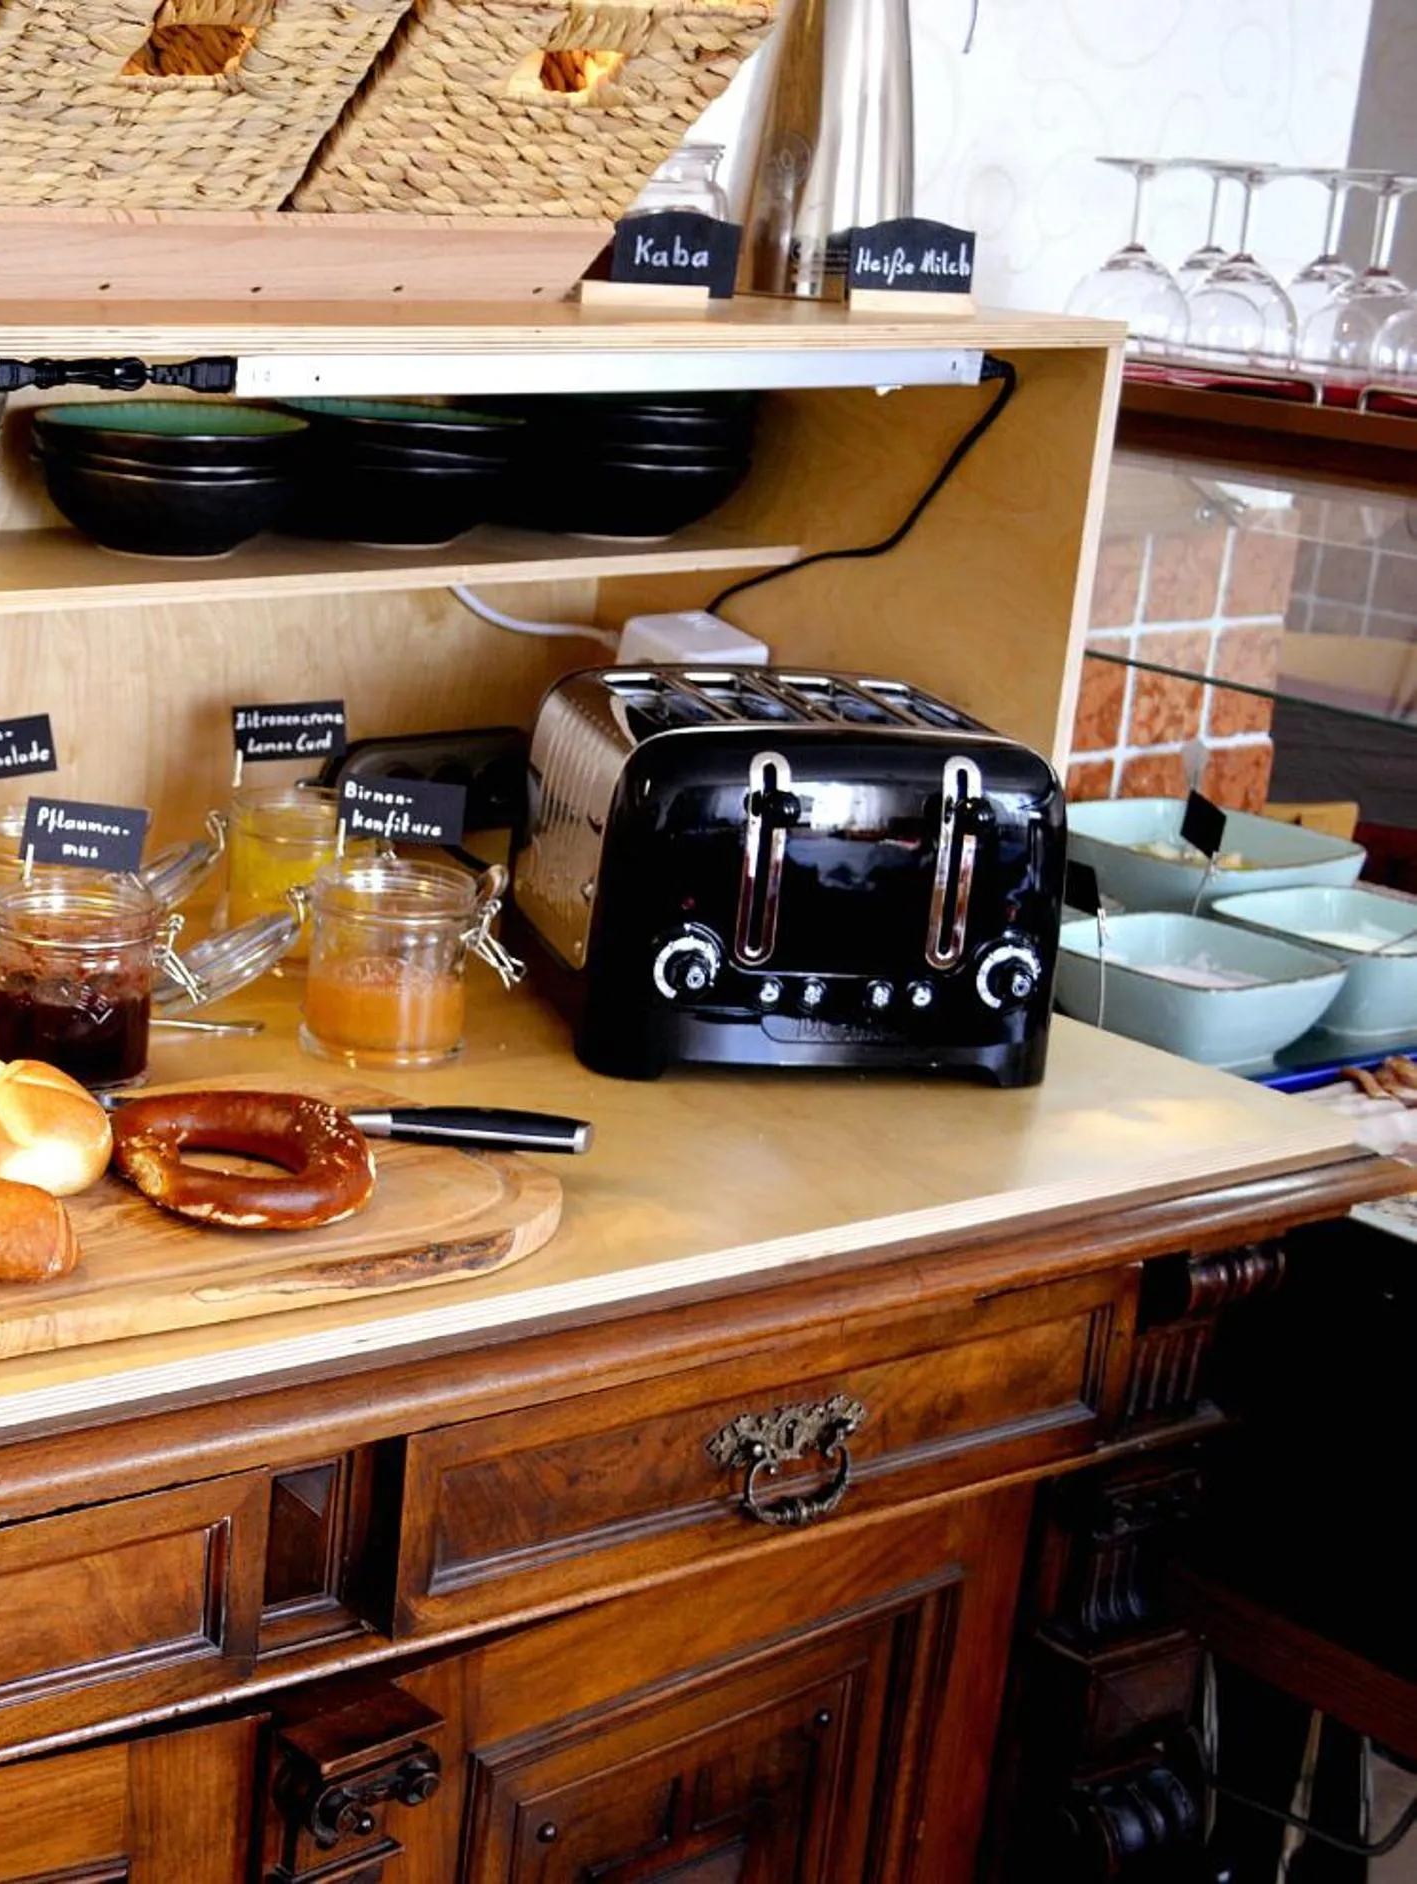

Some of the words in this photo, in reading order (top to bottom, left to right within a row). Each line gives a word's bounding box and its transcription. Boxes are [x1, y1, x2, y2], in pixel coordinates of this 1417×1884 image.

[633, 233, 709, 268] Kaba
[854, 246, 914, 285] Heiße
[919, 243, 971, 278] Milch
[295, 731, 332, 753] Curd
[62, 843, 98, 859] mus
